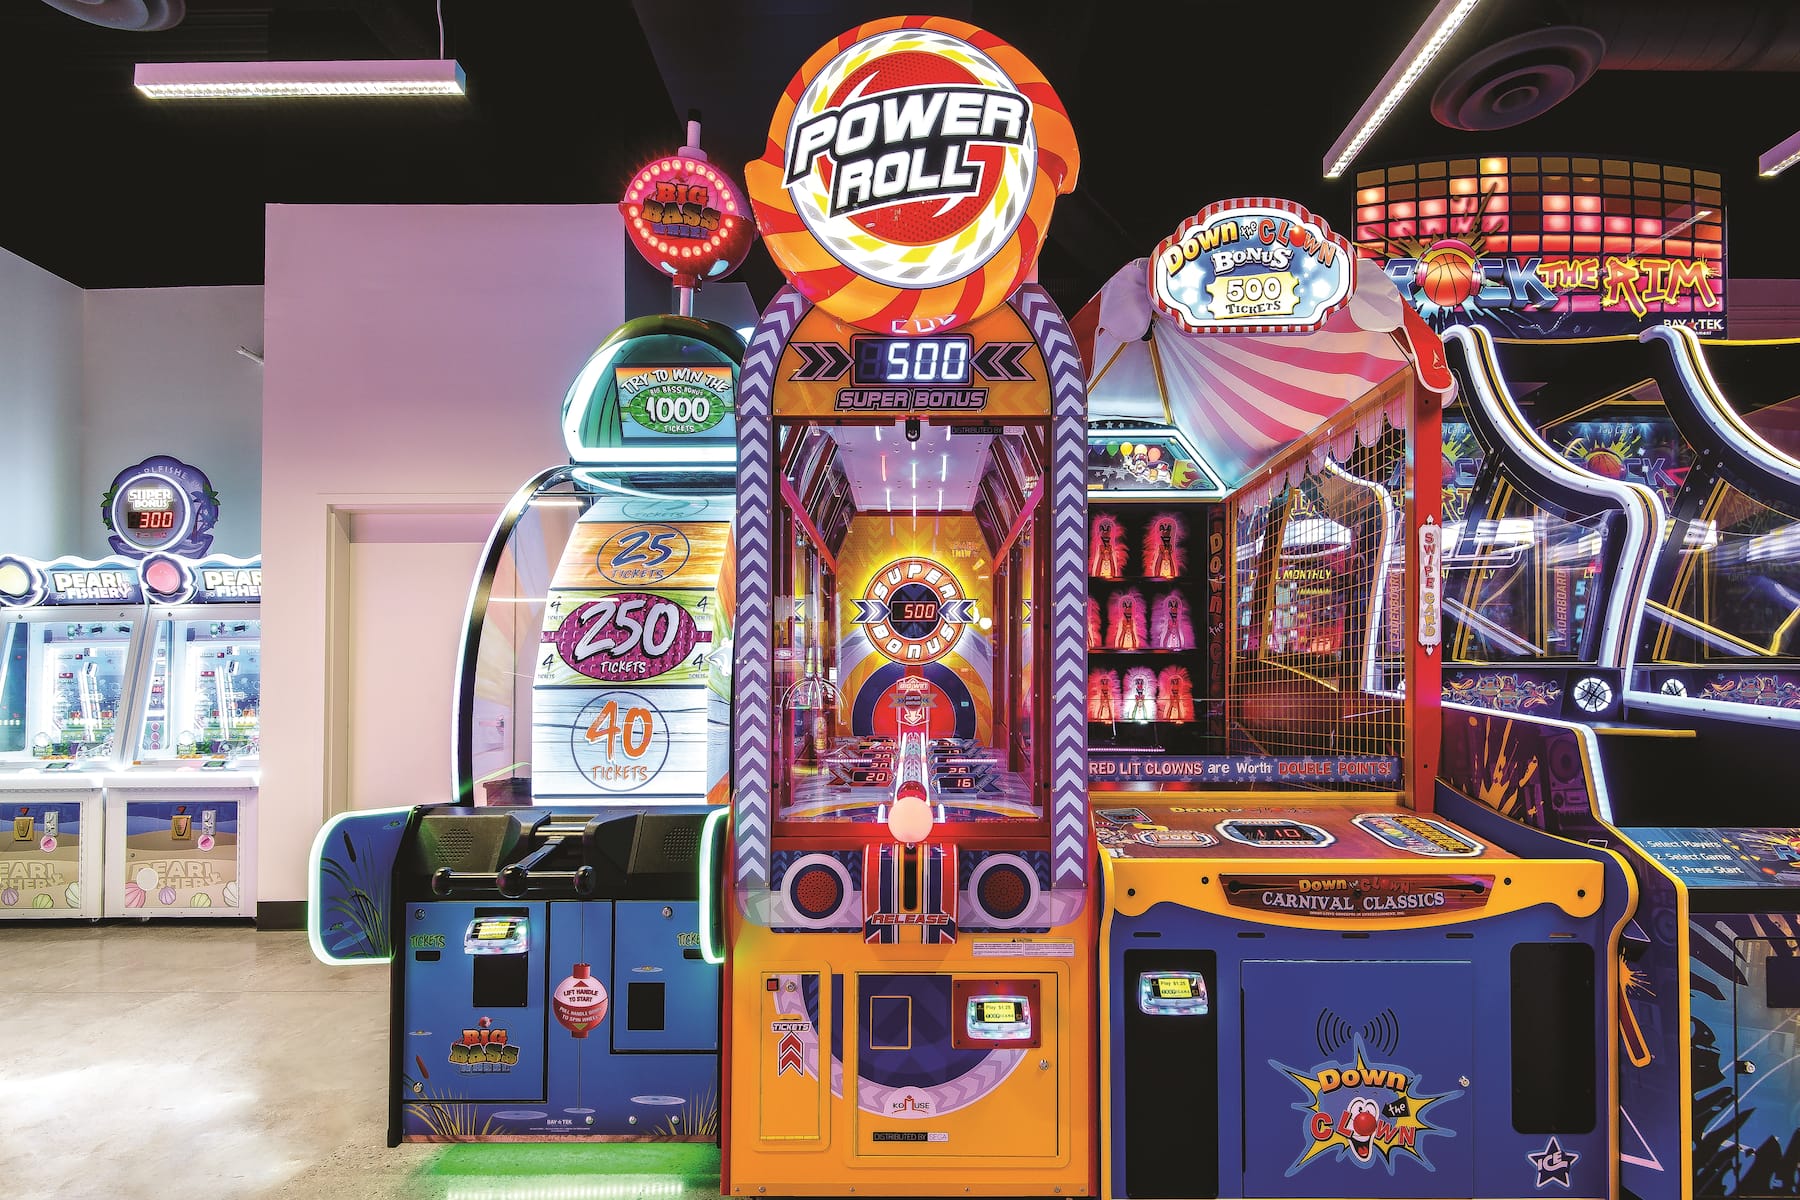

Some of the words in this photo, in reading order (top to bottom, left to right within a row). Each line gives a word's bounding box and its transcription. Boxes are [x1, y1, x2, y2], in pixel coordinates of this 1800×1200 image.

[791, 91, 1030, 178] POWER
[835, 143, 975, 210] ROLL
[656, 181, 709, 206] BIG
[641, 199, 722, 231] BASS
[1240, 221, 1259, 239] the
[1212, 248, 1293, 275] BONUS
[1227, 277, 1282, 302] 500
[1538, 258, 1600, 290] THE
[1604, 256, 1718, 318] RIM
[1225, 301, 1282, 315] TICKETS
[1698, 319, 1724, 330] TEK
[887, 342, 966, 380] 500
[620, 373, 649, 394] TRY
[652, 369, 669, 382] TO
[672, 368, 703, 383] WIN
[705, 374, 730, 392] THE
[838, 390, 908, 408] SUPER
[914, 390, 986, 408] BONUS
[646, 396, 710, 422] 1000
[663, 425, 695, 433] TICKETS
[129, 488, 172, 500] SUPER
[133, 499, 168, 509] BONUS
[139, 511, 173, 528] 300
[611, 530, 677, 567] 25
[1424, 533, 1436, 589] SWIPE
[612, 568, 665, 579] TICKETS
[873, 563, 957, 600] SUPER
[1283, 569, 1332, 580] MONTHLY
[1575, 580, 1586, 596] 5
[550, 595, 562, 614] 4
[696, 595, 708, 613] 4
[904, 604, 935, 618] 500
[1575, 605, 1586, 620] 6
[1424, 592, 1436, 637] CARD
[571, 599, 681, 664] 250
[872, 622, 955, 660] BONUS
[542, 653, 555, 672] 4
[601, 661, 648, 673] TICKETS
[692, 653, 704, 671] 4
[585, 700, 654, 761] 40
[592, 765, 649, 781] TICKETS
[865, 772, 886, 782] 20
[1089, 761, 1116, 775] RED
[1119, 761, 1142, 774] LIT
[1146, 761, 1203, 775] CLOWNS
[1207, 764, 1230, 774] are
[1236, 762, 1271, 774] Worth
[1278, 761, 1332, 775] DOUBLE
[1337, 761, 1392, 776] POINTS!
[957, 779, 971, 788] 16
[1683, 841, 1722, 849] Players
[1701, 853, 1732, 861] Game
[1717, 866, 1745, 874] Start
[1299, 879, 1348, 893] Down
[1262, 891, 1355, 911] CARNIVAL
[1363, 892, 1445, 911] CLASSICS
[872, 914, 949, 925] RELEASE
[410, 933, 446, 949] TICKETS
[773, 1023, 810, 1031] TICKETS
[462, 1029, 507, 1046] BIG
[449, 1042, 520, 1065] BASS
[1317, 1068, 1408, 1094] Down
[1388, 1103, 1406, 1116] the
[874, 1133, 914, 1141] DISTRIBUTED
[916, 1133, 927, 1141] BY
[1537, 1150, 1569, 1172] ICE
